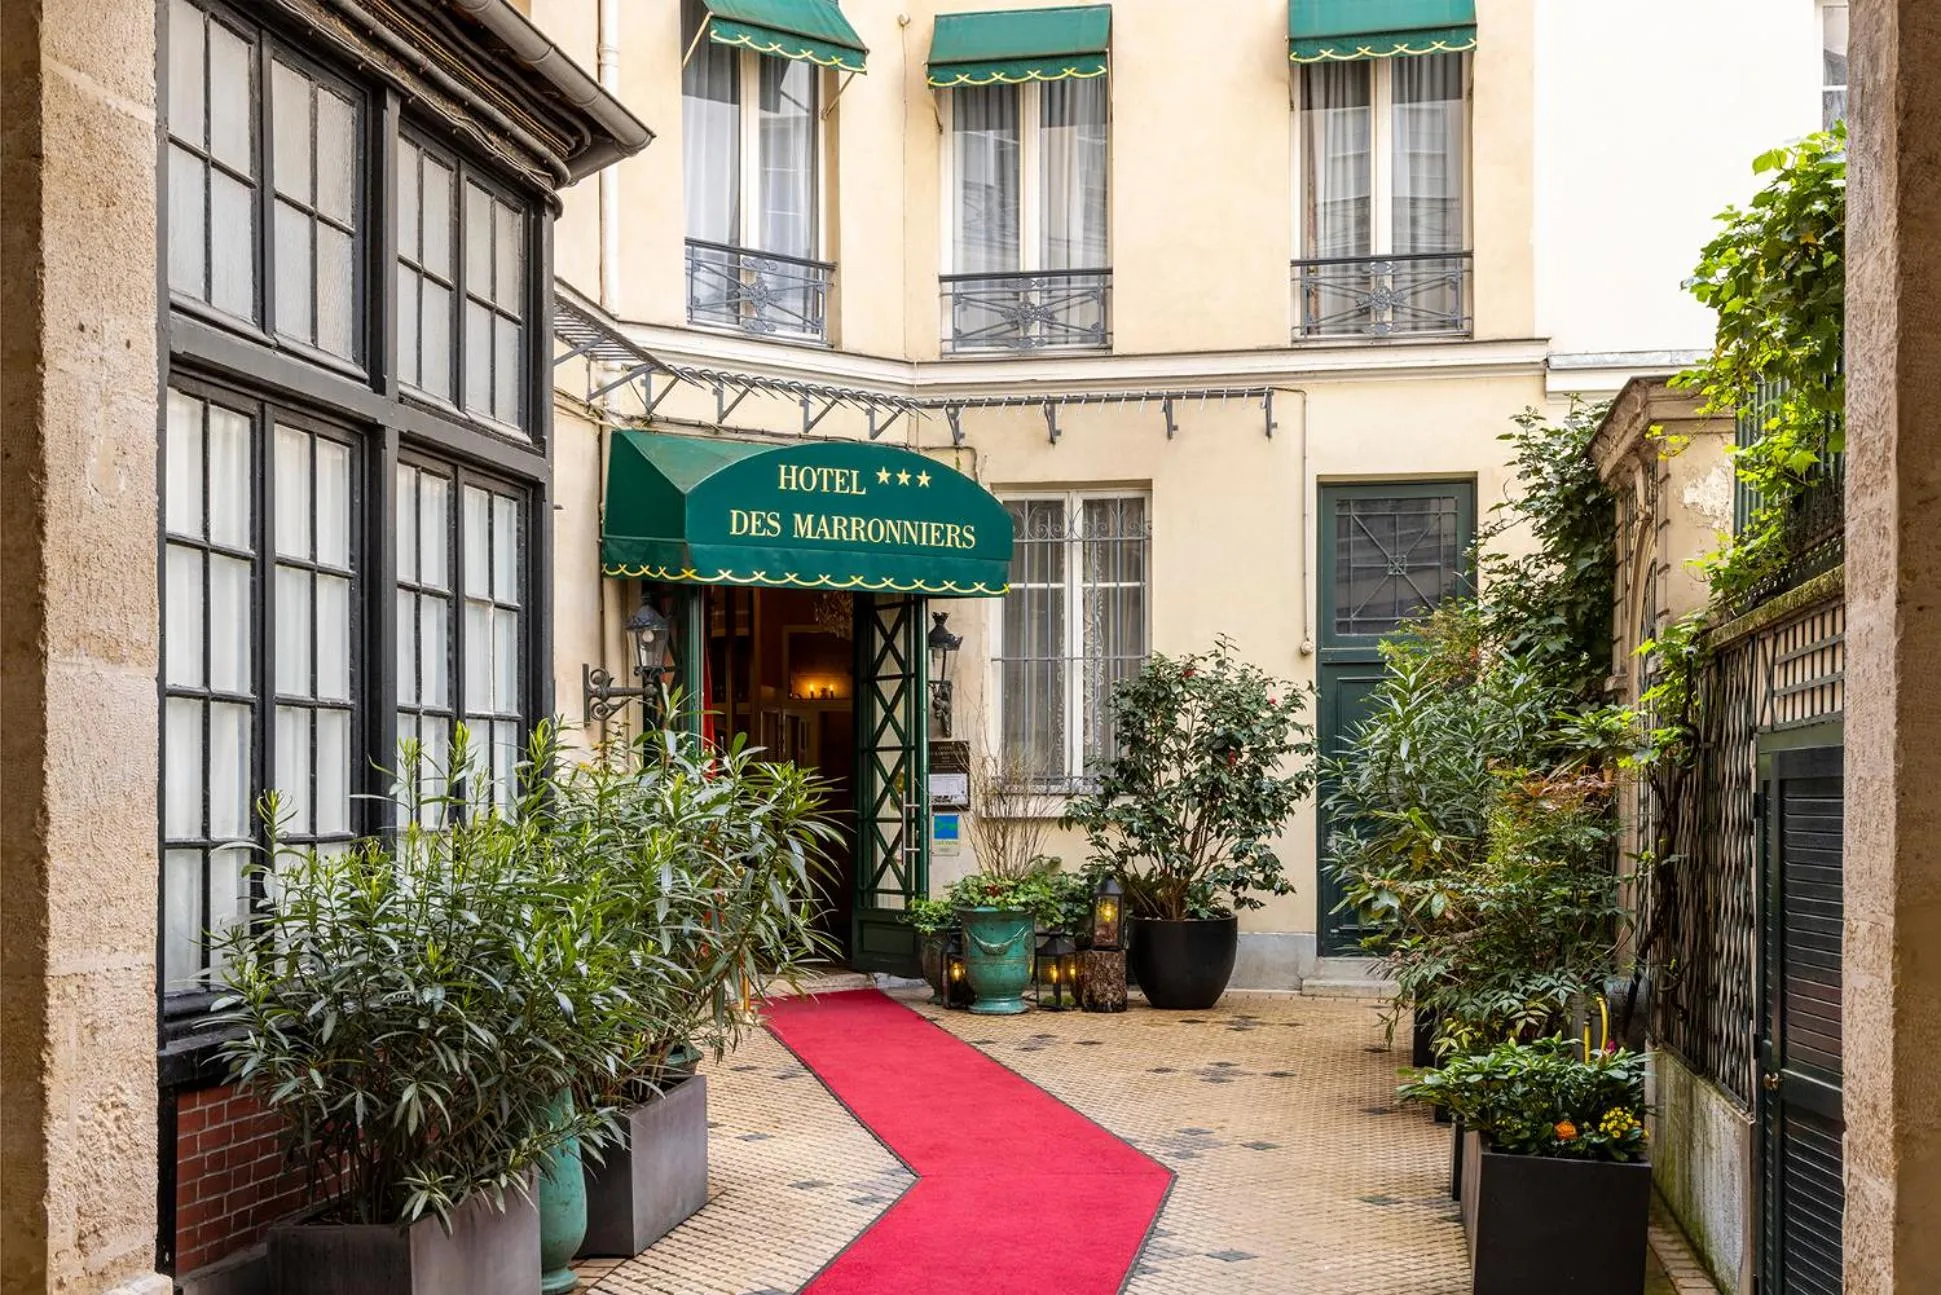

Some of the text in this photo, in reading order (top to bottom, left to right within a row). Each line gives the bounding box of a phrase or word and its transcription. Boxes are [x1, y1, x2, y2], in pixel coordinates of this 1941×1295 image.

[778, 464, 867, 495] HOTEL
[729, 510, 976, 550] DES MARRONNIERS
